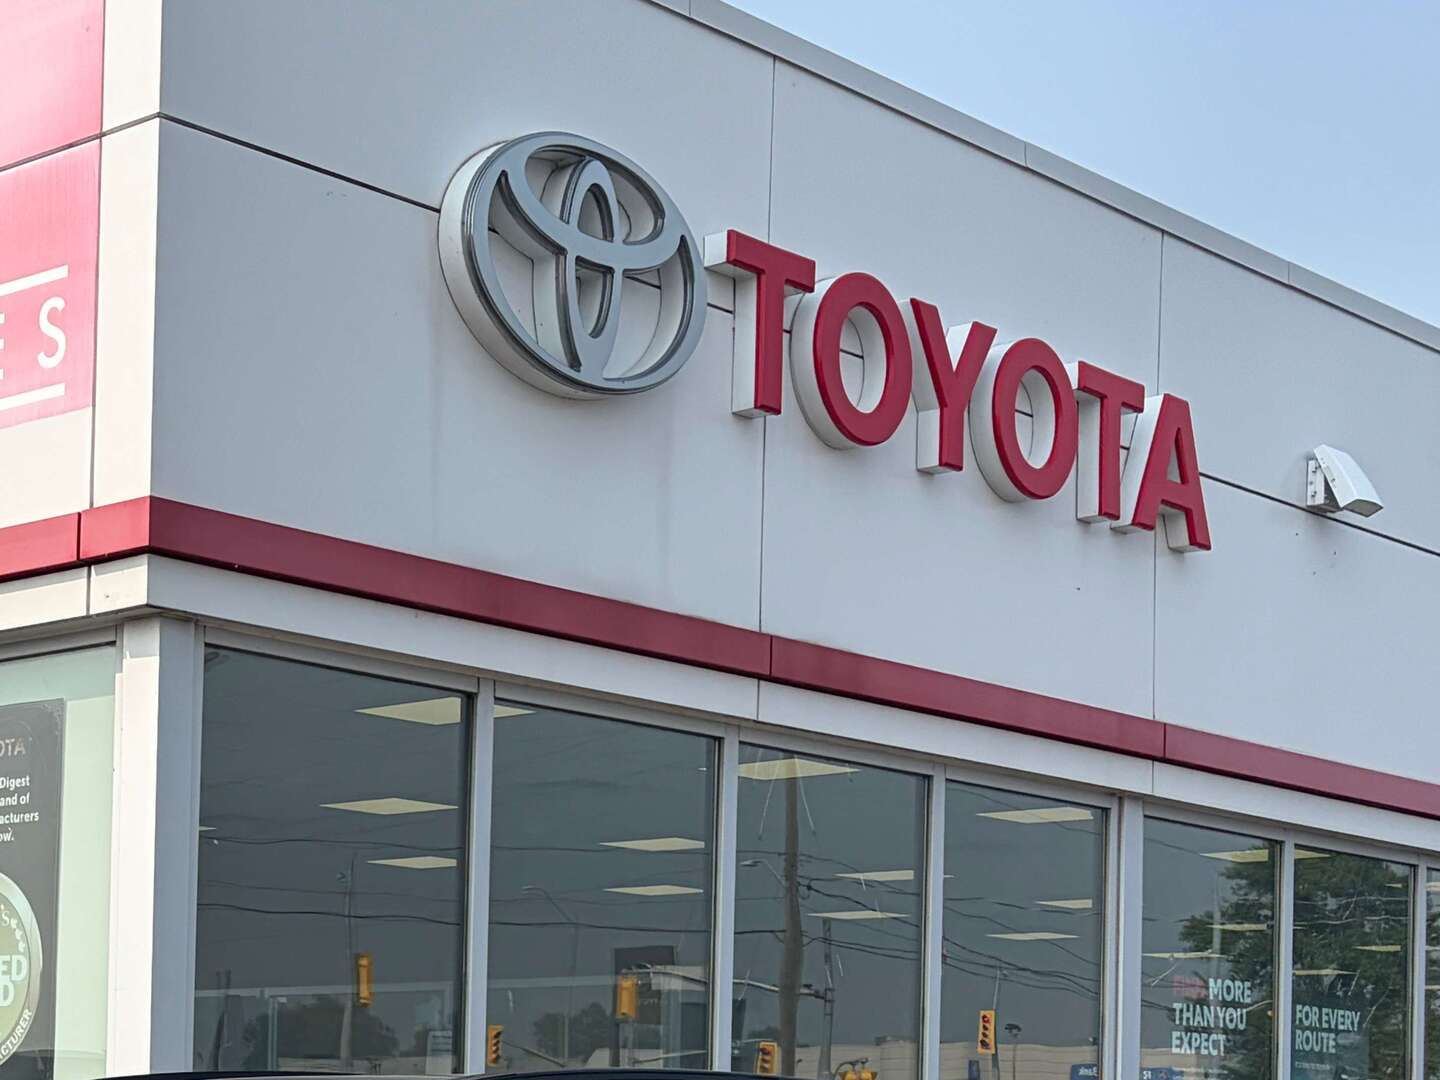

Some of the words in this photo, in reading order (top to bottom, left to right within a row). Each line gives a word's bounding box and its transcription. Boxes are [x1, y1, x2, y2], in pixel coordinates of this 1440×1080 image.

[720, 228, 1212, 552] TOYOTA
[0, 775, 30, 791] Digest
[19, 791, 31, 804] of
[1208, 977, 1252, 1003] MORE
[1172, 1002, 1214, 1028] THAN
[1215, 1006, 1248, 1030] YOU
[1296, 1004, 1320, 1027] FOR
[1321, 1007, 1360, 1031] EVERY
[1171, 1030, 1227, 1056] EXPECT
[1296, 1029, 1336, 1053] ROUTE
